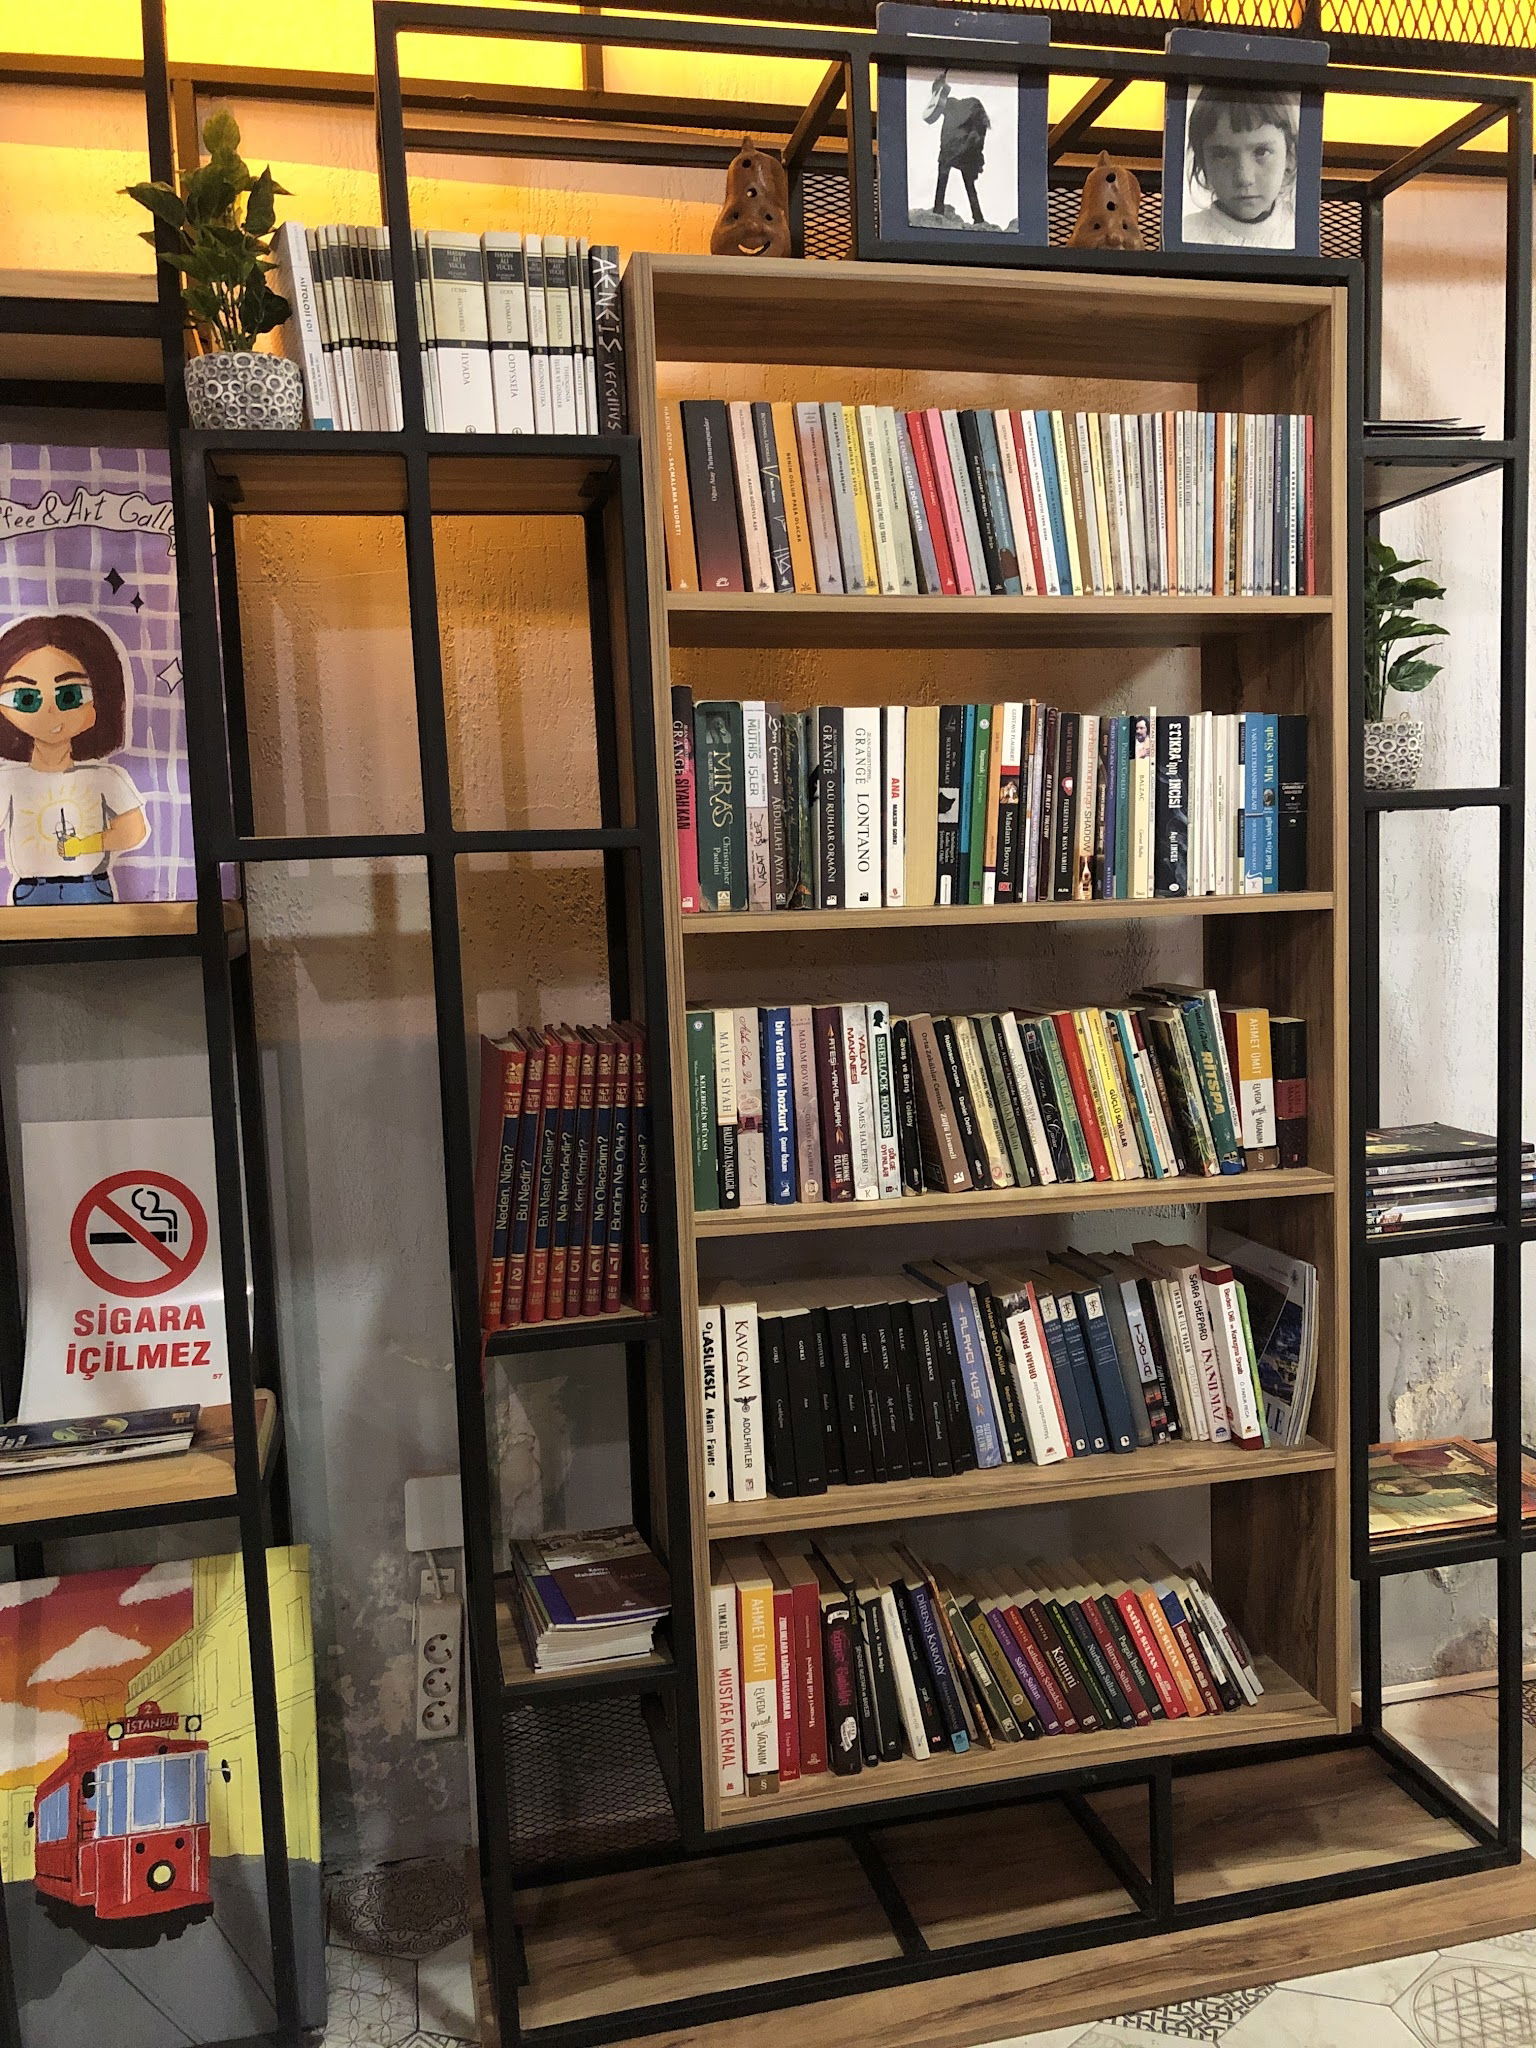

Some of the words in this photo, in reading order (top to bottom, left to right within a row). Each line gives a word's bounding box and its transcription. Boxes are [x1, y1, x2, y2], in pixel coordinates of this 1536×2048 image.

[505, 300, 513, 333] HOMEROS
[592, 257, 622, 352] AENEIS
[668, 458, 678, 503] SAÇMALAMA
[788, 475, 796, 497] OĞLUM
[43, 496, 60, 525] &
[63, 492, 107, 523] Art
[790, 500, 798, 516] PAŞA
[914, 510, 923, 531] KADIN
[794, 518, 802, 542] OLACAK
[676, 779, 690, 807] SİYAH
[827, 781, 837, 801] ÖLÜ
[892, 778, 900, 799] ANA
[677, 810, 691, 830] KAN
[772, 796, 784, 851] ABDULLAH
[826, 804, 836, 841] RUHLAR
[857, 794, 870, 872] LONTANO
[1005, 812, 1013, 844] Madam
[1083, 811, 1092, 852] SHADOW
[713, 848, 721, 875] Paolini
[723, 837, 731, 885] Christopher
[774, 855, 785, 885] AYATA
[827, 843, 836, 882] ORMANI
[1002, 847, 1011, 876] Bovary
[720, 1031, 731, 1053] MAİ
[775, 1020, 785, 1036] bir
[1250, 1018, 1260, 1049] AHMET
[776, 1038, 786, 1070] vatan
[799, 1029, 808, 1062] MADAM
[847, 1027, 860, 1084] MAKİNESİ
[858, 1034, 868, 1075] YALAN
[899, 1037, 908, 1059] Savaş
[944, 1034, 955, 1064] Robinson
[721, 1059, 730, 1072] VE
[877, 1036, 888, 1091] SHERLOCK
[902, 1063, 909, 1072] ve
[951, 1065, 961, 1087] Crusoe
[1251, 1053, 1262, 1074] ÜMİT
[777, 1073, 787, 1086] iki
[801, 1064, 810, 1097] BOVARY
[902, 1073, 911, 1092] Barış
[721, 1077, 735, 1111] SİYAH
[958, 1096, 969, 1116] Daniel
[777, 1089, 788, 1132] bozkurt
[857, 1101, 866, 1128] JAMES
[881, 1095, 891, 1136] HOLMES
[905, 1100, 914, 1126] Tolstoy
[940, 1113, 951, 1132] Zülfü
[1109, 1089, 1121, 1113] GÜÇLÜ
[1115, 1114, 1128, 1147] SORULAR
[723, 1126, 734, 1144] HALİD
[963, 1117, 973, 1135] Defoe
[724, 1145, 735, 1159] ZİYA
[859, 1130, 869, 1173] HALPERIN
[945, 1132, 957, 1159] Livaneli
[558, 1132, 573, 1201] Nerededir?
[575, 1139, 589, 1186] Kimdir?
[612, 1164, 625, 1184] Ne
[722, 1160, 735, 1190] UŞAKLIGİL
[834, 1154, 843, 1183] COLLINS
[842, 1153, 850, 1181] SUZANNE
[518, 1160, 532, 1201] Nedir?
[516, 1205, 528, 1221] Bu
[557, 1205, 568, 1222] Ne
[574, 1189, 584, 1211] Kim
[594, 1204, 604, 1221] Ne
[538, 1211, 549, 1227] Bu
[511, 1268, 522, 1281] 2
[537, 1262, 545, 1276] 3
[570, 1260, 580, 1272] 5
[591, 1260, 601, 1272] 6
[609, 1258, 619, 1271] 7
[1173, 1289, 1184, 1309] İNSAN
[1189, 1274, 1199, 1298] SARA
[74, 1303, 206, 1337] SİGARA
[1177, 1310, 1185, 1319] NE
[1179, 1321, 1188, 1331] İLE
[1193, 1300, 1208, 1341] SHEPARD
[1223, 1288, 1232, 1310] Beden
[1230, 1330, 1240, 1356] Konuşma
[923, 1329, 931, 1356] ANATOLE
[984, 1297, 1000, 1345] Mevlana'dan
[995, 1346, 1007, 1376] Öyküler
[1018, 1319, 1031, 1349] PAMUK
[1180, 1333, 1191, 1353] YAŞAR
[66, 1341, 212, 1381] İÇİLMEZ
[735, 1320, 752, 1389] KAVGAM
[880, 1345, 889, 1369] AUSTEN
[960, 1317, 974, 1364] ALAYCI
[969, 1372, 982, 1399] KUŞ
[1024, 1352, 1038, 1379] ORHAN
[926, 1358, 934, 1381] FRANCE
[706, 1407, 715, 1433] Adam
[706, 1438, 716, 1466] Fawer
[718, 1603, 727, 1628] YILMAZ
[751, 1598, 765, 1639] AHMET
[719, 1631, 729, 1650] ÖZDİL
[915, 1594, 933, 1632] DİRENİŞ
[927, 1633, 947, 1676] KARATAY
[1126, 1604, 1144, 1635] SAFİYE
[1140, 1636, 1159, 1669] SULTAN
[1148, 1602, 1165, 1634] SAFİYE
[1162, 1634, 1179, 1668] SULTAN
[753, 1644, 767, 1672] ÜMİT
[1050, 1646, 1080, 1688] Kanuni
[1087, 1643, 1108, 1674] Nurbanu
[1102, 1675, 1117, 1697] Sultan
[1104, 1642, 1122, 1670] Hürrem
[1118, 1670, 1132, 1693] Sultan
[1130, 1658, 1147, 1686] İbrahim
[1014, 1656, 1029, 1677] Safiye
[1026, 1678, 1042, 1700] Sultan
[718, 1667, 734, 1724] MUSTAFA
[127, 1716, 179, 1734] İSTANBUL
[721, 1728, 736, 1769] KEMAL
